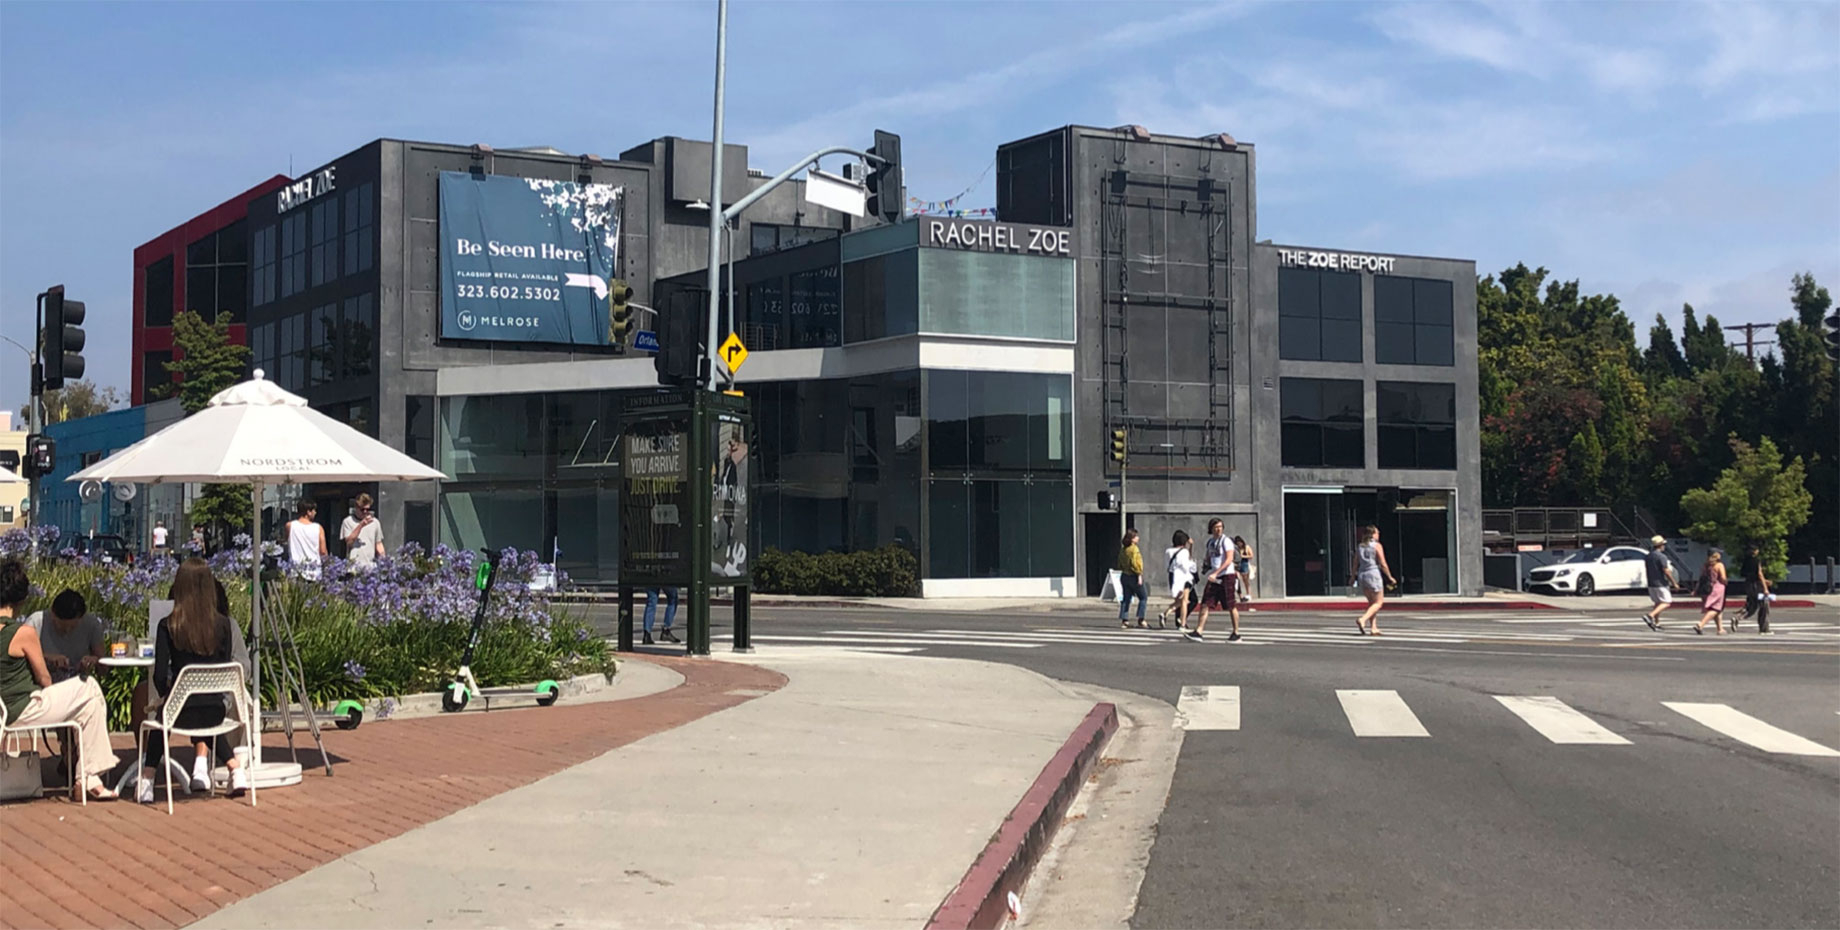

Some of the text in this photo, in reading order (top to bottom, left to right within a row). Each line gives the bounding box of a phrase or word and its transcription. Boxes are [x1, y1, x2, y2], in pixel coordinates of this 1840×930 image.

[930, 221, 1070, 253] RACHEL ZOE
[457, 238, 587, 262] Be Seen Here.
[1279, 249, 1396, 272] THE ZOE REPORT
[494, 272, 519, 280] RETAIL
[521, 273, 558, 282] AVAILABLE
[457, 284, 560, 301] 323.602.5302
[481, 316, 540, 327] MELROSE
[630, 394, 682, 406] INFORMATION
[631, 434, 680, 454] MAKE SURE
[240, 458, 343, 466] NORDSTROM
[630, 455, 681, 474] YOU ARRIVE.
[630, 475, 681, 495] JUST DRIVE.
